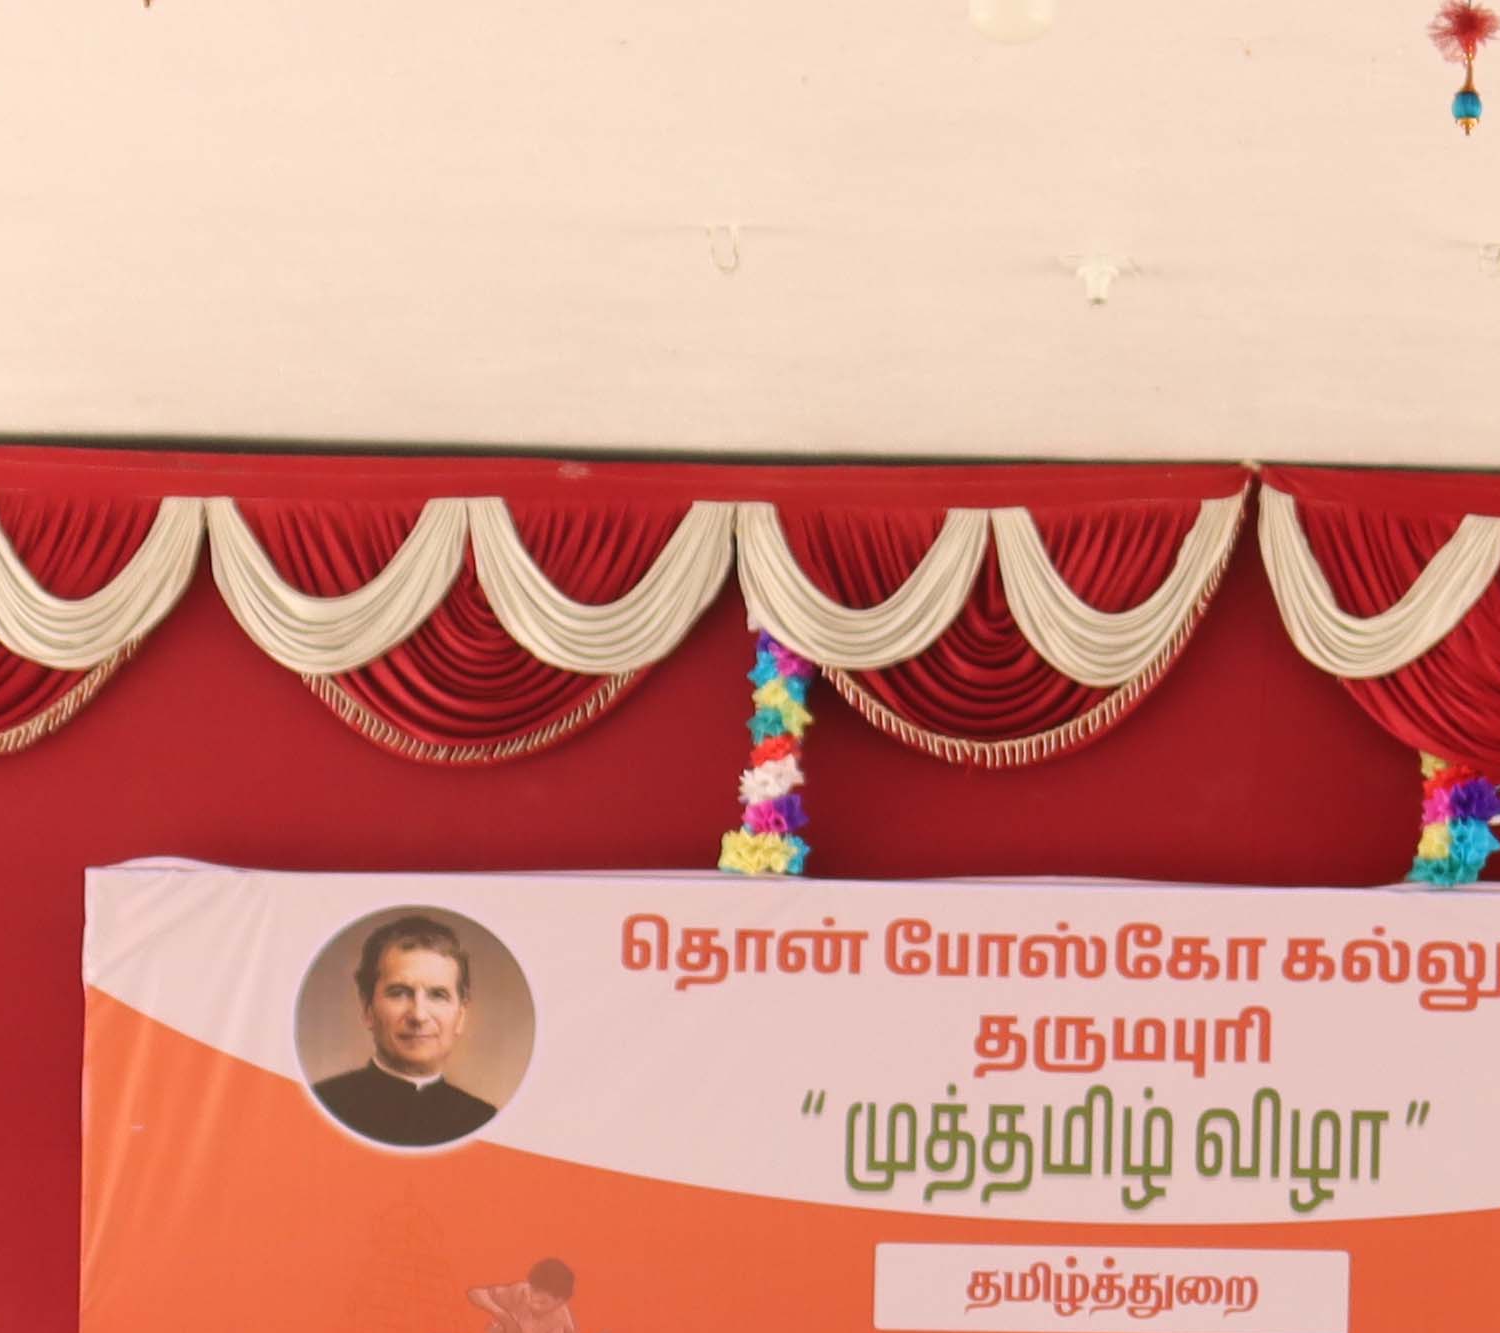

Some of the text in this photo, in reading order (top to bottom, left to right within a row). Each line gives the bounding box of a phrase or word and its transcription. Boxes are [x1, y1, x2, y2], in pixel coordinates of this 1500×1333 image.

[621, 914, 868, 991] தொன்
[886, 917, 1267, 981] போஸ்கோ
[974, 1005, 1271, 1078] தருமபுரி
[845, 1083, 1173, 1214] முத்தமிழ்
[1196, 1088, 1389, 1213] விழா
[965, 1256, 1259, 1319] தமிழ்த்துறை
